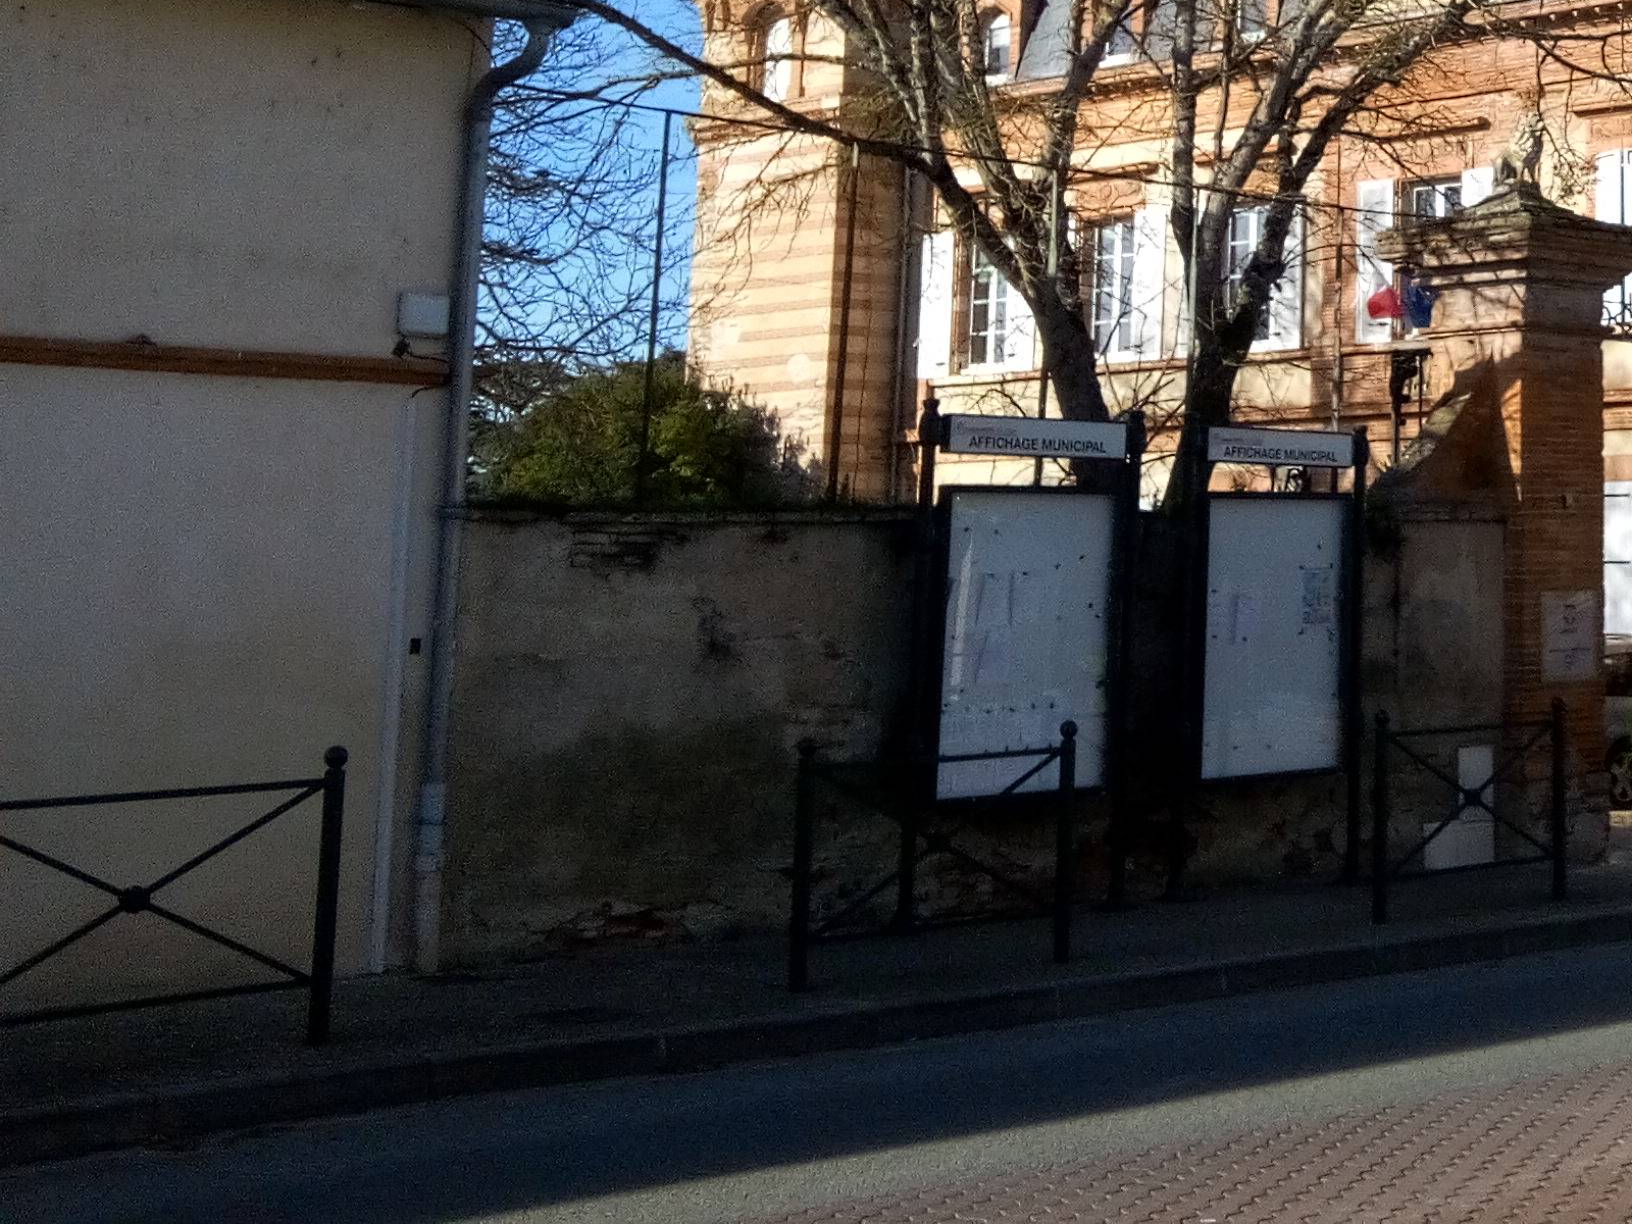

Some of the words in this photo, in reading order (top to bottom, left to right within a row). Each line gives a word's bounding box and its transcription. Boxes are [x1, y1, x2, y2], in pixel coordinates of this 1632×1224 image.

[968, 435, 1037, 451] AFFICHAGE
[1041, 438, 1107, 454] MUNICIPAL
[1223, 445, 1281, 460] AFFICHAGE
[1284, 448, 1338, 463] MUNICIPAL
